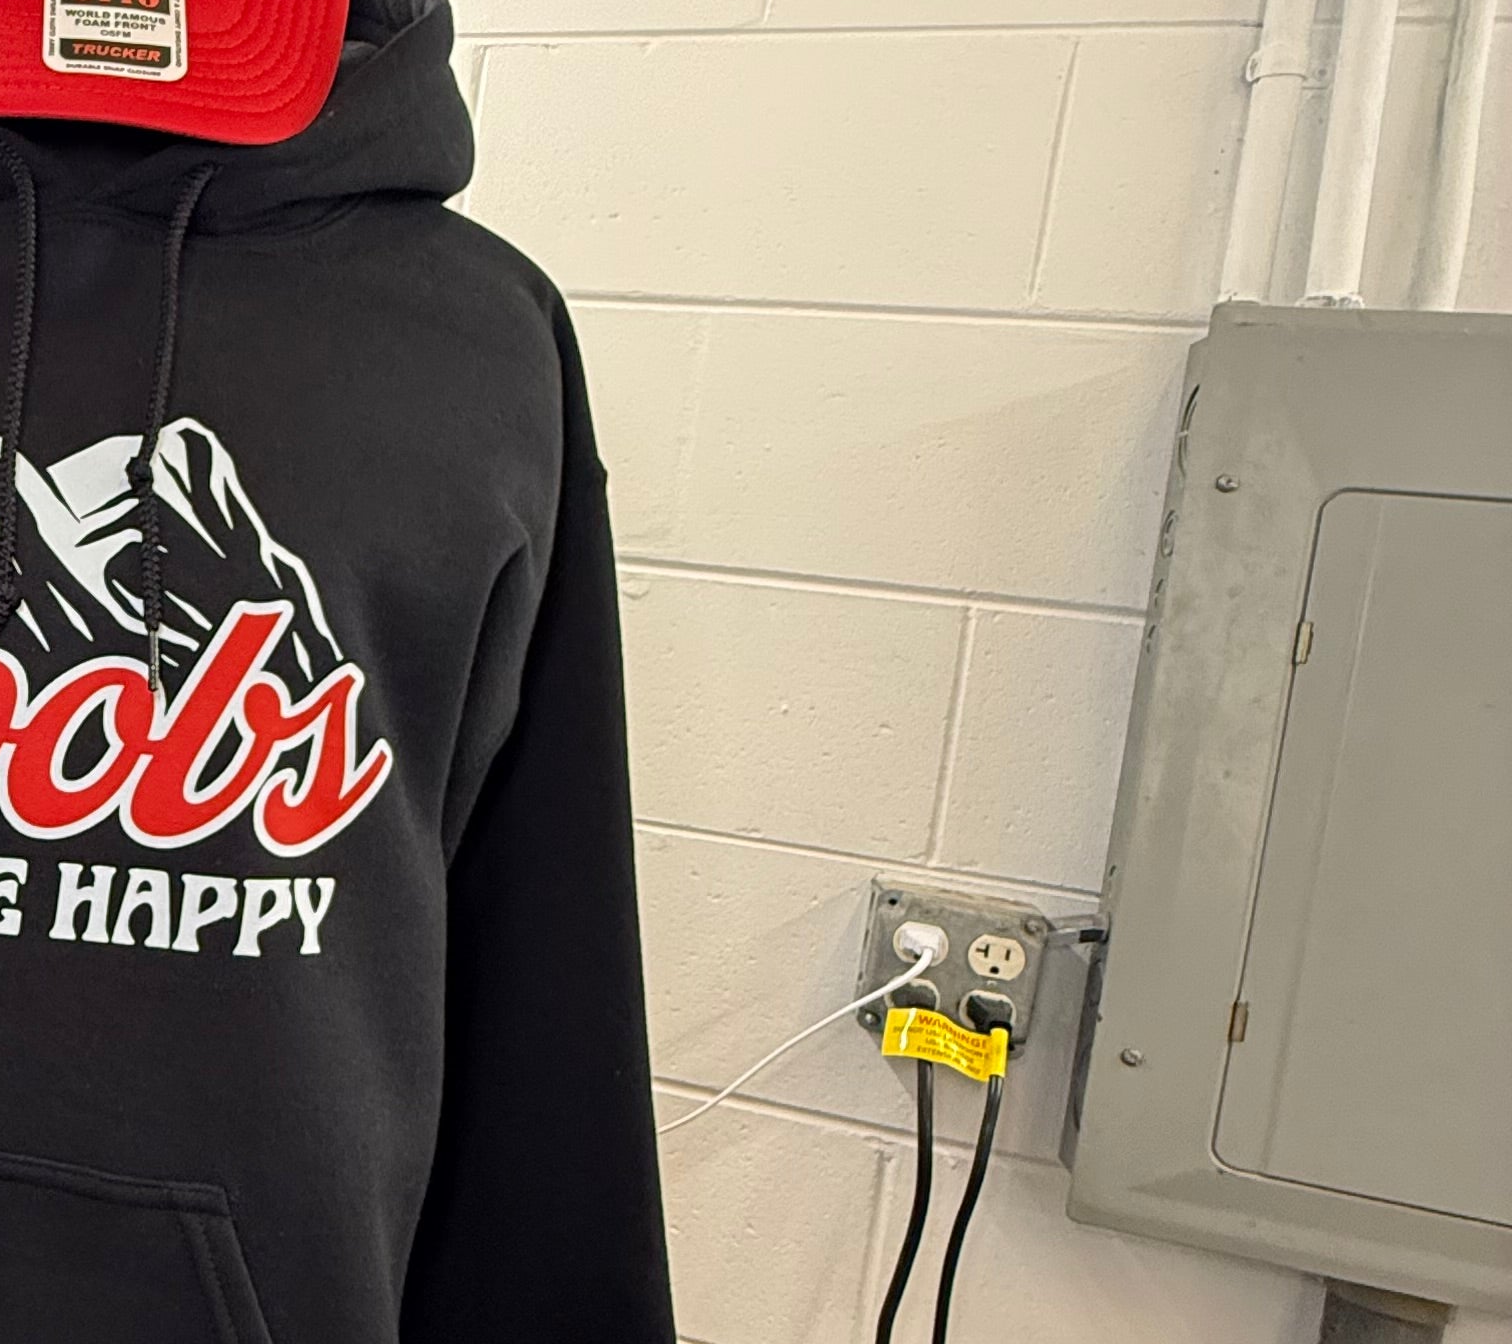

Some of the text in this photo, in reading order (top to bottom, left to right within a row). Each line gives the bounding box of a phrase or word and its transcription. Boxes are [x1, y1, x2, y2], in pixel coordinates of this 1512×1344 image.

[65, 9, 166, 25] WORLD FAMOUS
[75, 18, 157, 31] FOAM FRONT
[100, 29, 131, 38] OSFM
[71, 43, 161, 62] TRUCKER
[48, 863, 336, 957] HAPPY
